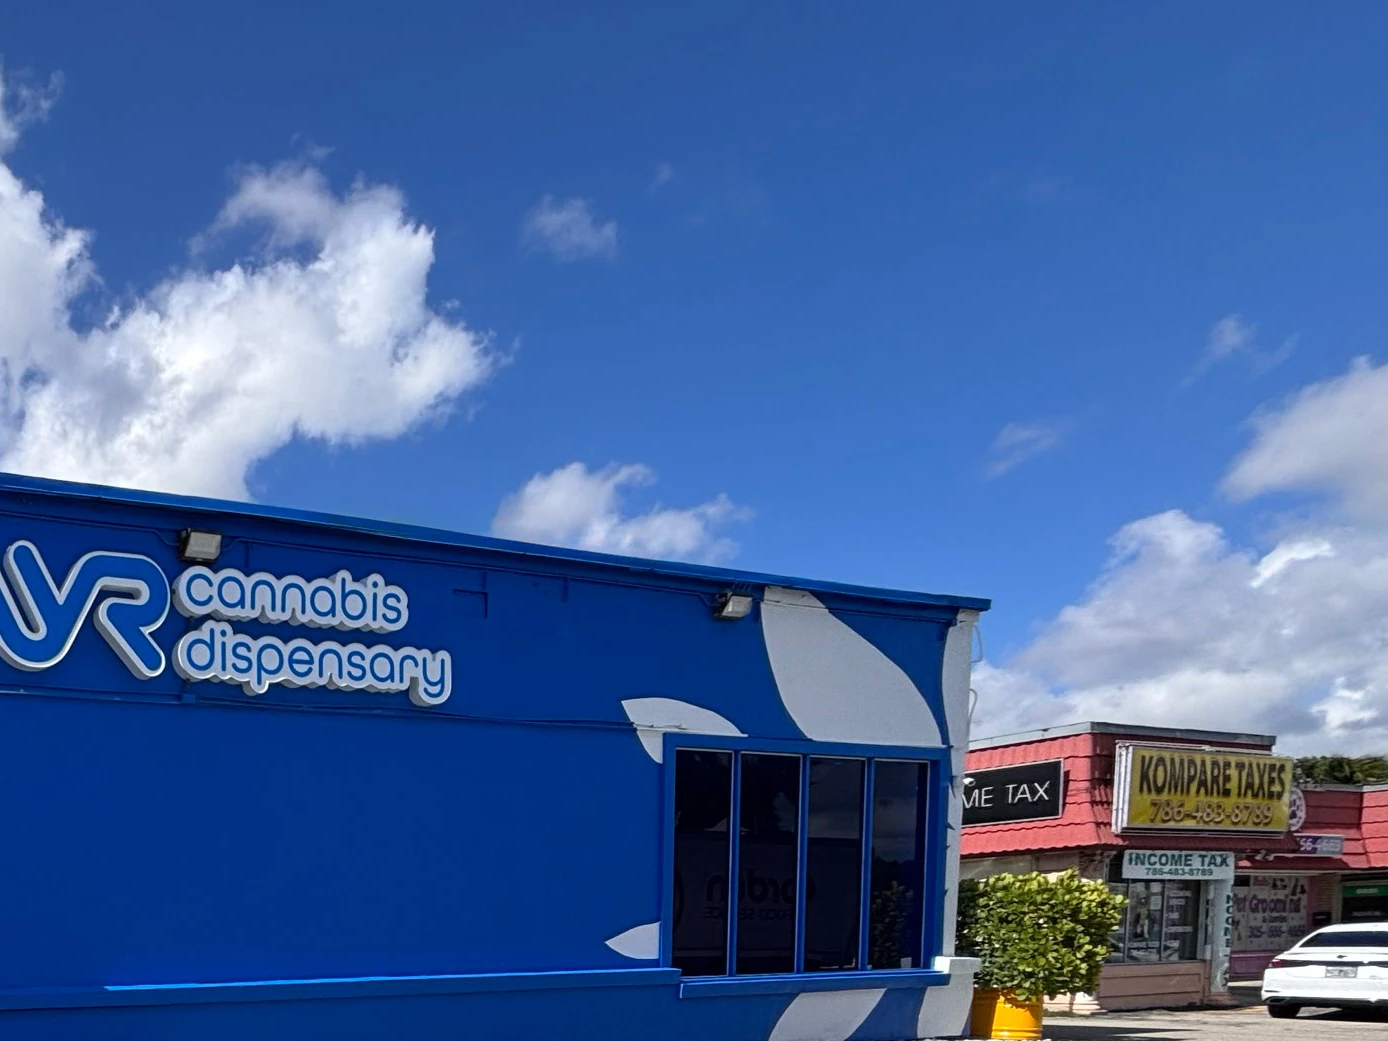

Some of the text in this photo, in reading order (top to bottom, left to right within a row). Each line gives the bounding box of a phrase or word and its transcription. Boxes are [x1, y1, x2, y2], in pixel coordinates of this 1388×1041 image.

[184, 566, 403, 624] cannabis
[184, 625, 447, 699] dispensary
[1005, 780, 1050, 804] TAX
[1138, 755, 1286, 800] KOMPARE TAXES
[1149, 799, 1273, 825] 786-483-8789
[1128, 853, 1229, 867] INCOME TAX
